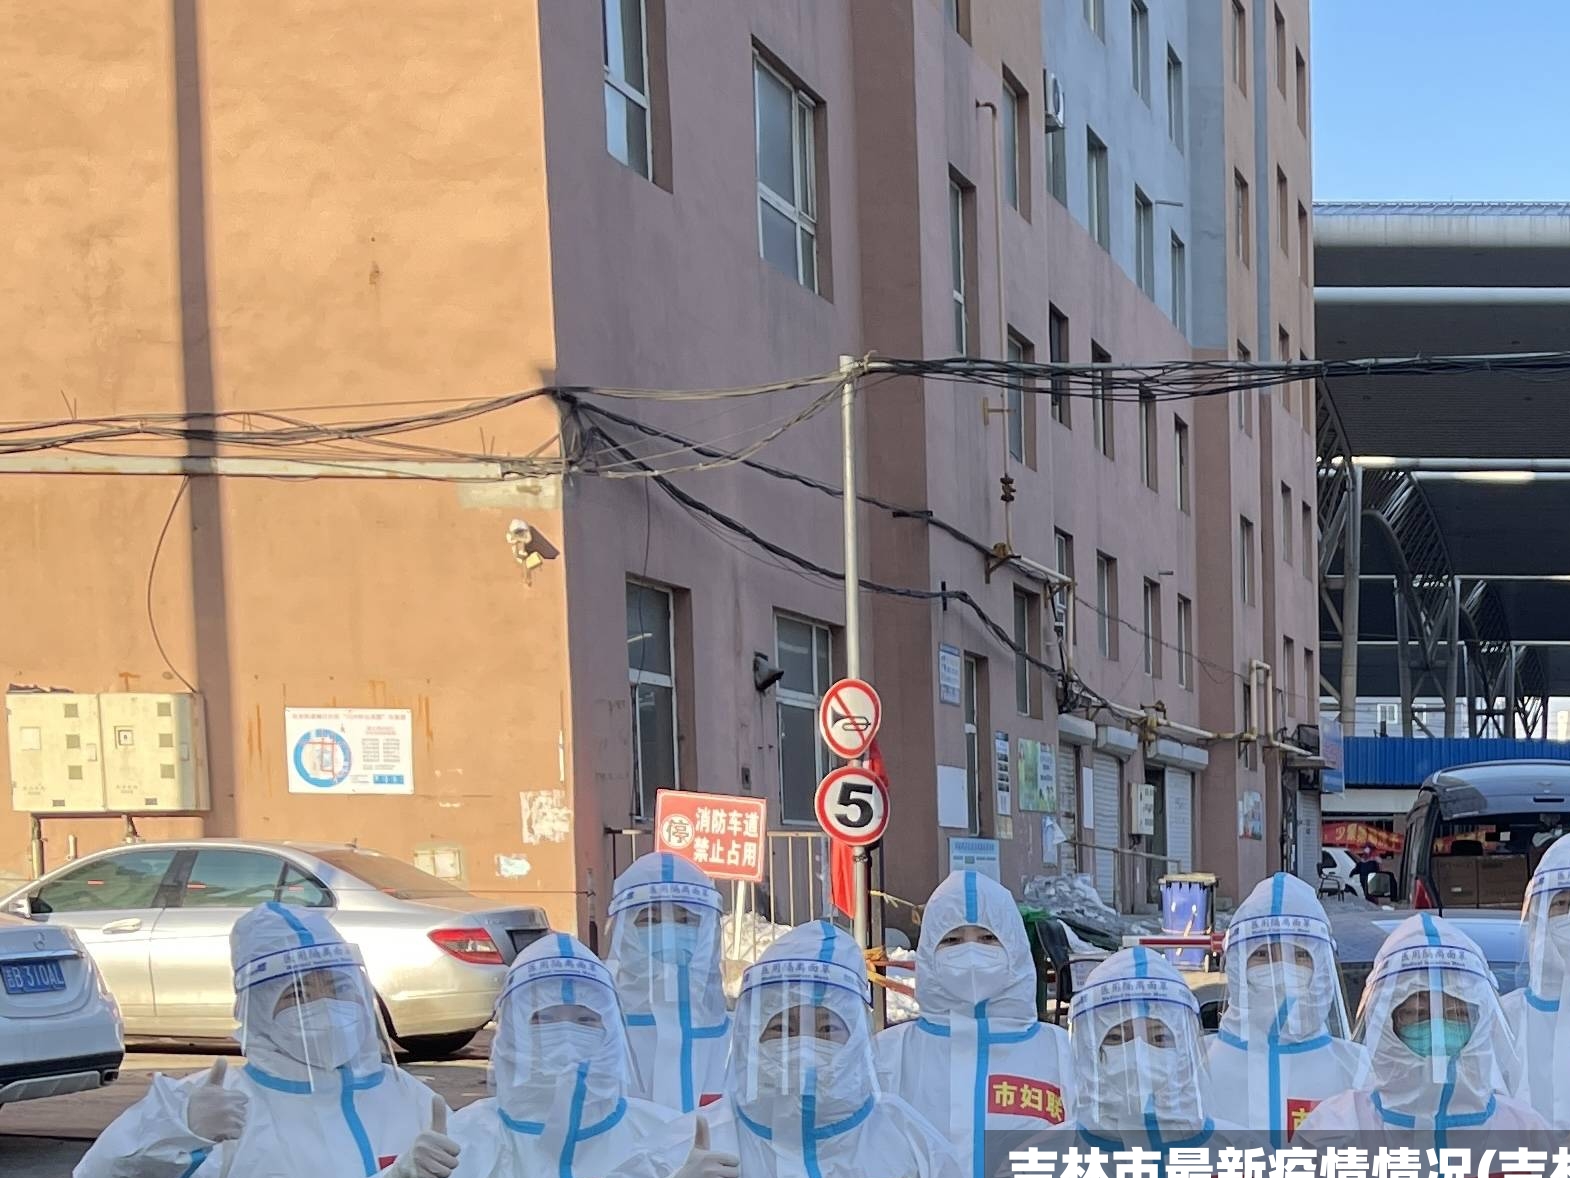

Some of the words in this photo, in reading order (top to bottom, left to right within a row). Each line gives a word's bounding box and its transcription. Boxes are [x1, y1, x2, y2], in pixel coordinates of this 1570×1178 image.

[835, 781, 874, 829] 5
[666, 818, 690, 843] 停
[695, 806, 759, 838] 消防车道
[693, 836, 757, 867] 禁止占用
